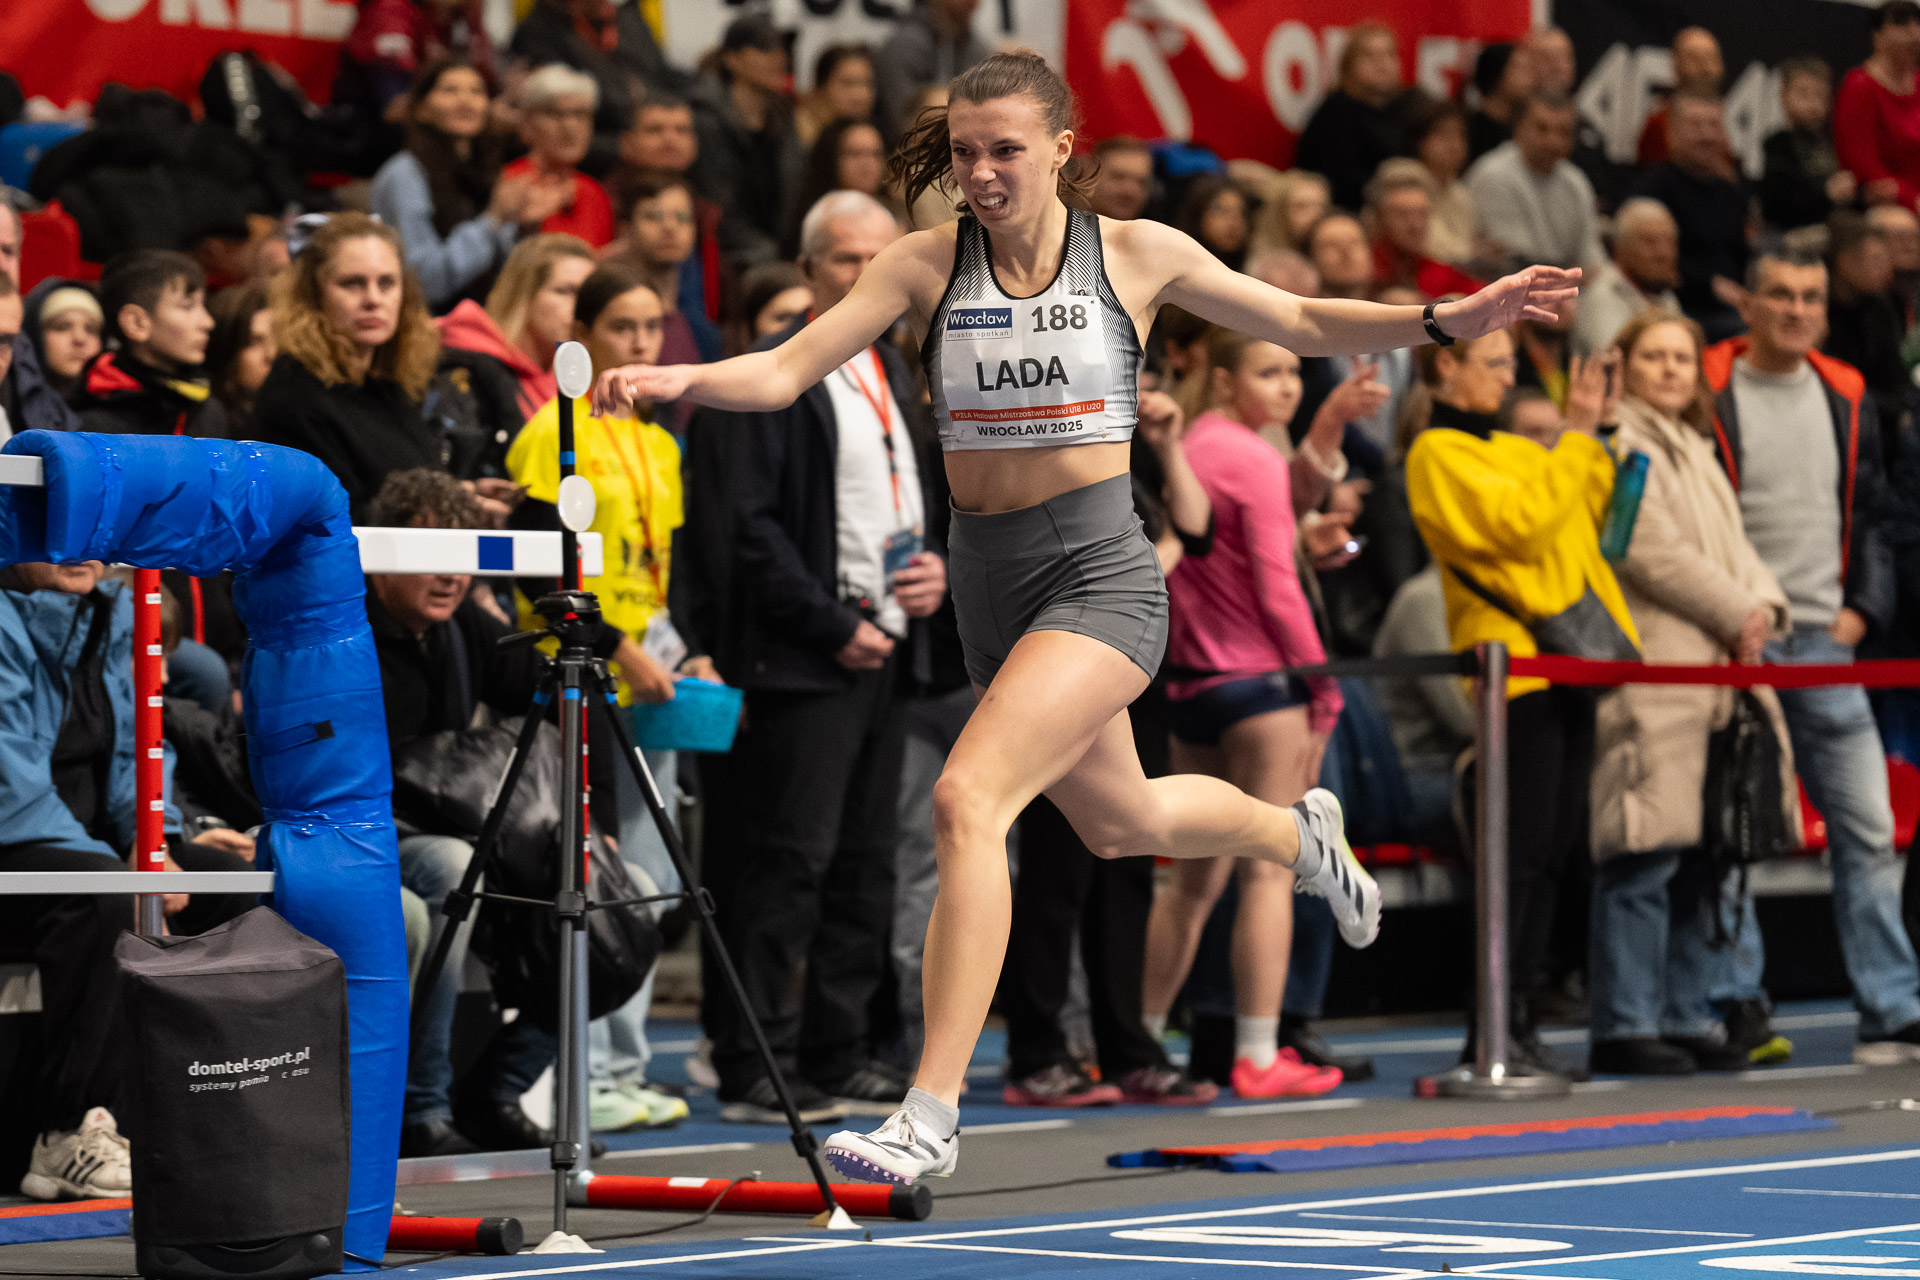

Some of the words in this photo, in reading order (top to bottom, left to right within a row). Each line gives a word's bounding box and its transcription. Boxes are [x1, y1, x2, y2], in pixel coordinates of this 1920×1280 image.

[949, 310, 1009, 326] Wrocław
[1031, 304, 1088, 333] 188
[948, 331, 973, 339] miasto
[976, 329, 1009, 338] spotkań
[976, 355, 1070, 392] LADA
[973, 411, 999, 420] Halowe
[1000, 409, 1046, 419] Mistrzostwa
[1046, 406, 1069, 416] Polski
[1069, 404, 1082, 414] U18
[1086, 402, 1102, 411] U20
[976, 424, 1048, 437] WROCŁAW
[1050, 419, 1083, 434] 2025
[188, 1047, 310, 1076] domtel-sport.pl
[188, 1081, 238, 1093] systemy
